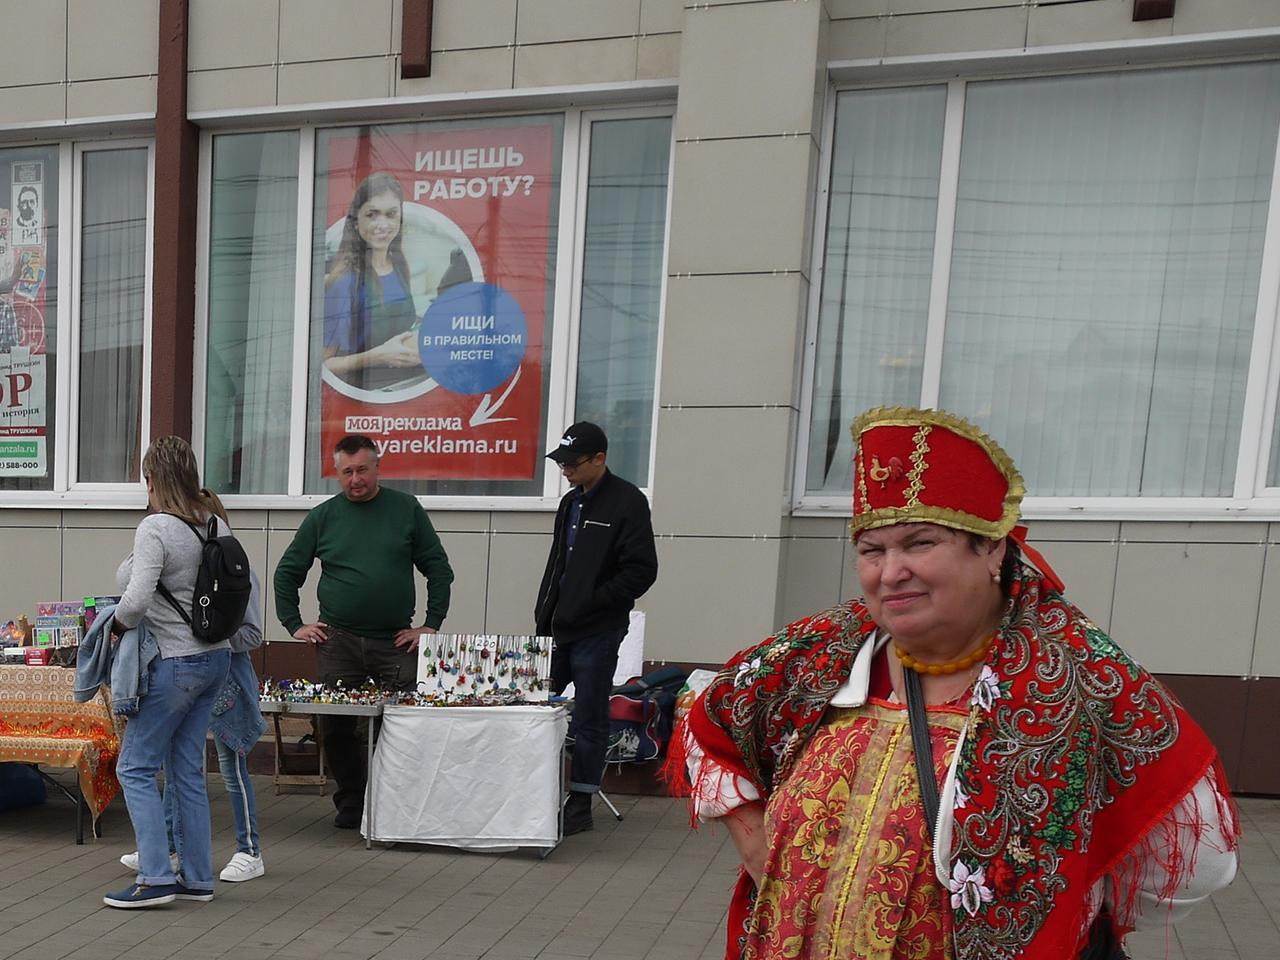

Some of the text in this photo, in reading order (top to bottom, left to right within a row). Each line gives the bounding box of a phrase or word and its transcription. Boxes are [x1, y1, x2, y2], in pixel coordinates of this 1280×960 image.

[414, 146, 524, 173] ИЩЕШЬ
[414, 175, 534, 200] РАБОТУ?
[452, 316, 494, 332] ИЩИ
[424, 334, 522, 346] В ПРАВИЛЬНОМ
[450, 350, 494, 360] МЕСТЕ!
[2, 407, 40, 418] история
[375, 436, 518, 458] yareklama.ru
